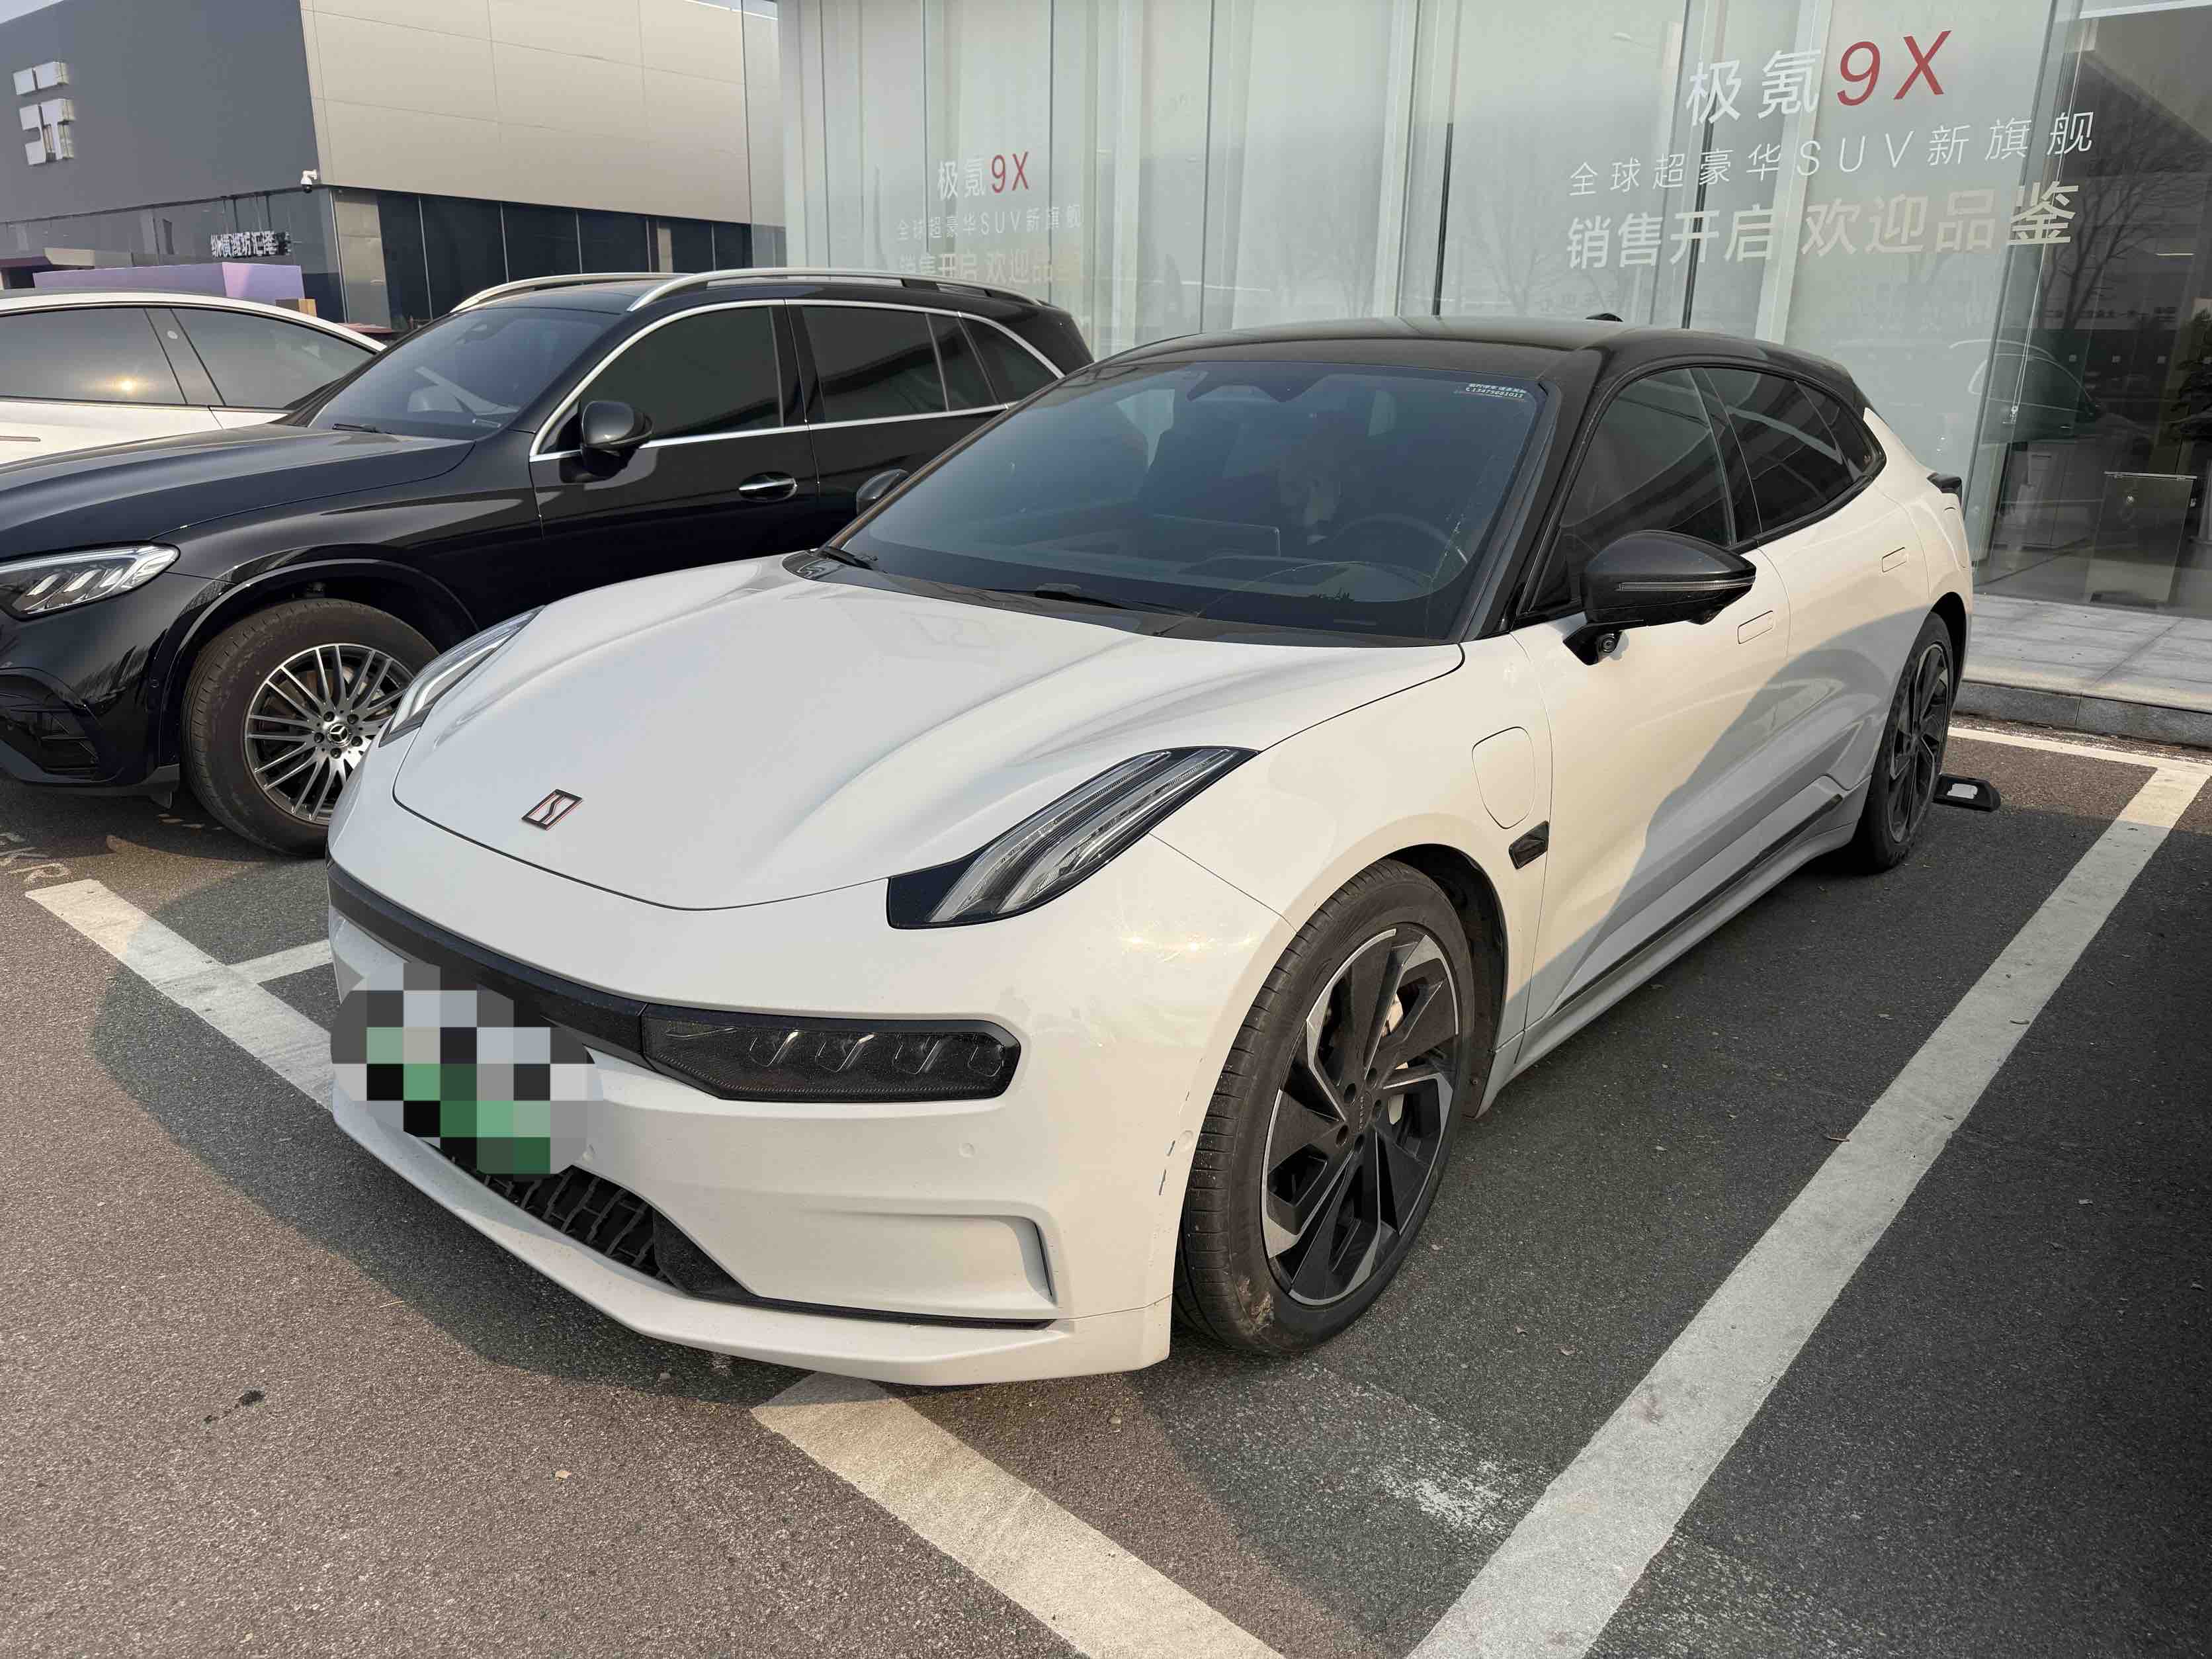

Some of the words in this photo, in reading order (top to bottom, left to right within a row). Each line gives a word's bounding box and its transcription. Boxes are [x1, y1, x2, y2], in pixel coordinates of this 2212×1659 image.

[1686, 30, 1952, 126] 极氪9X
[937, 151, 1029, 200] 极氪9X
[1569, 111, 2094, 196] 全球超豪华SUV新旗舰
[1566, 203, 1775, 270] 销售开启
[1801, 181, 2079, 257] 欢迎品鉴
